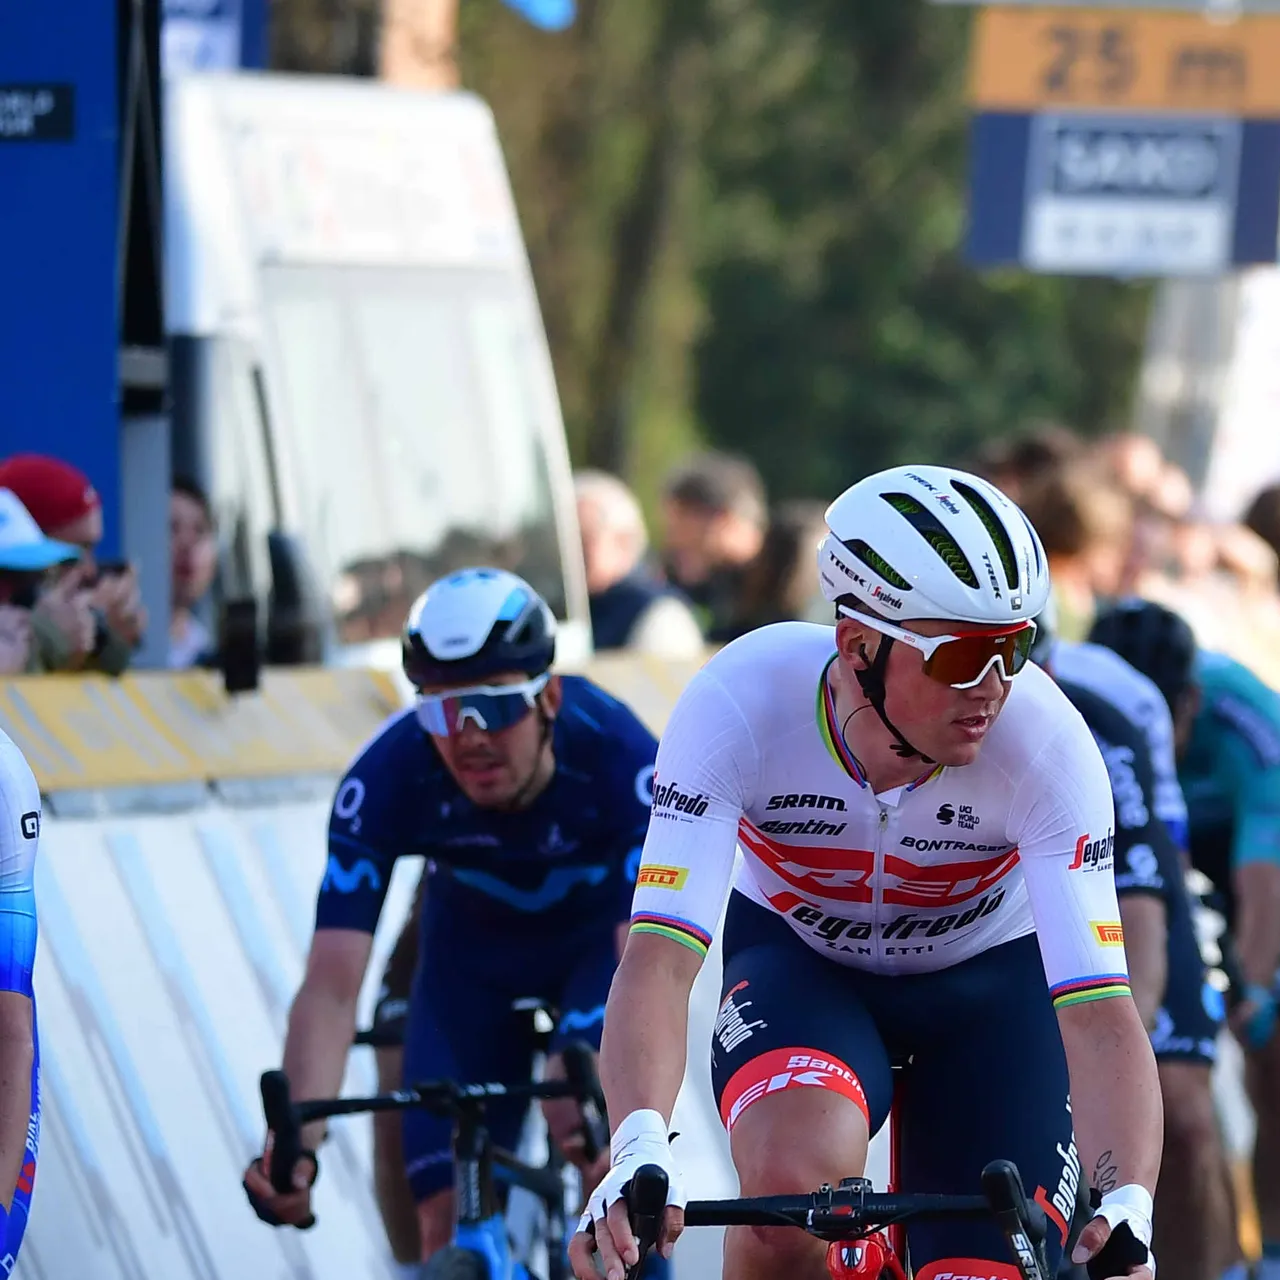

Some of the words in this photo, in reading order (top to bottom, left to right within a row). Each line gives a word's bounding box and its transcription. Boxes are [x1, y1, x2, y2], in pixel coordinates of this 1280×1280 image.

[828, 550, 868, 588] TREK
[981, 552, 1003, 600] TREK
[958, 813, 980, 825] WORLD
[638, 868, 680, 885] ELLI
[1096, 925, 1125, 942] PIRE
[825, 941, 934, 955] ZANETTI
[727, 1071, 834, 1131] EK
